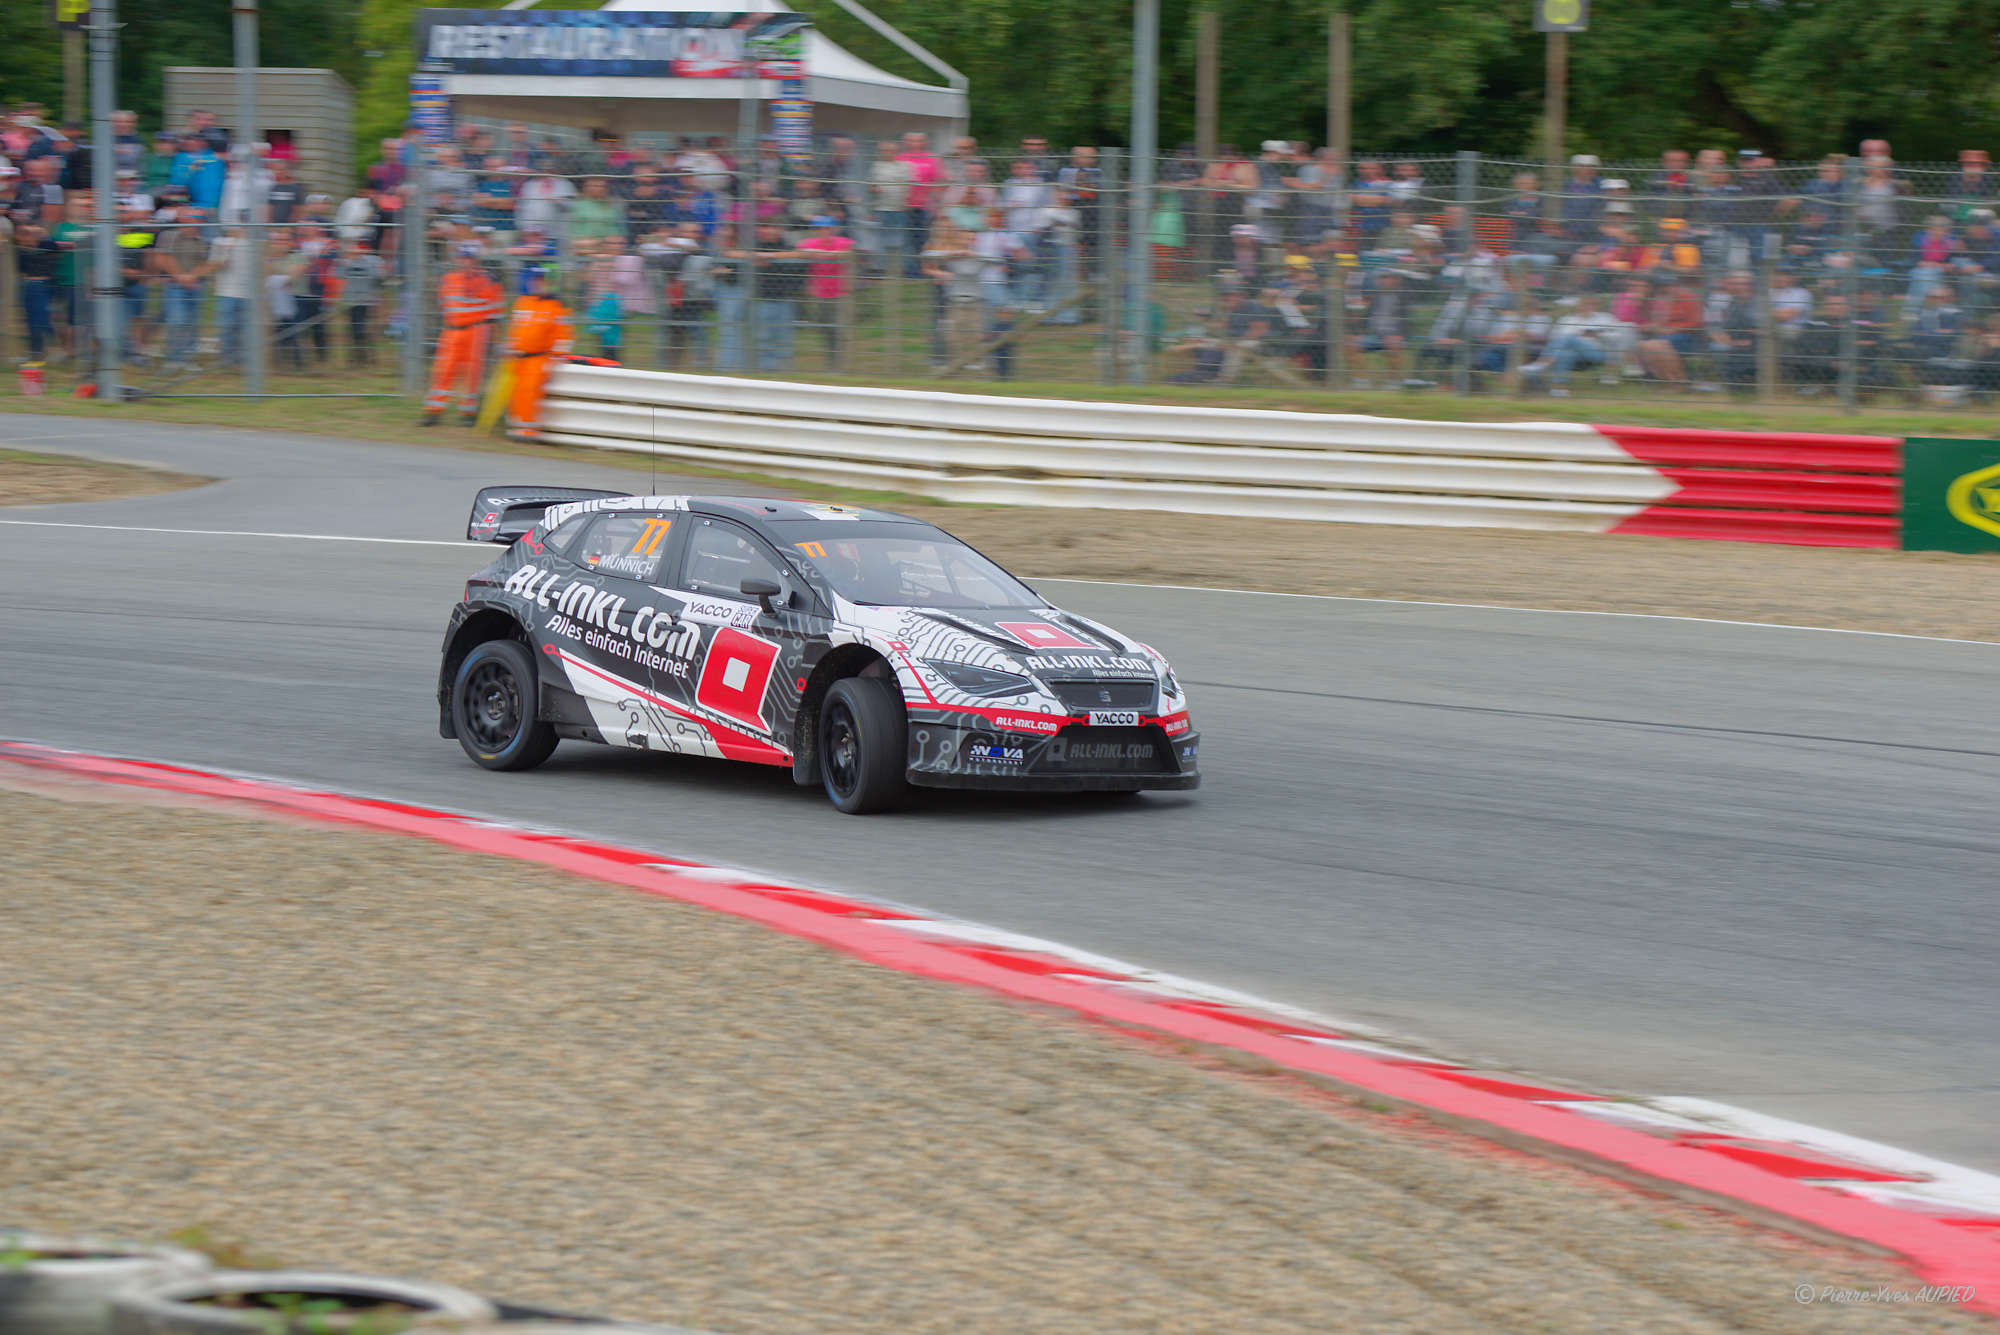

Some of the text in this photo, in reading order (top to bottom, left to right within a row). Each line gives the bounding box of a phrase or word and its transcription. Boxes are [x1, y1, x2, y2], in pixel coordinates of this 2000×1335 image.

[632, 517, 672, 555] 77
[794, 541, 828, 558] 77
[599, 553, 655, 576] MÜNNICH
[689, 601, 732, 618] YACCO
[545, 614, 689, 679] Alles einfach Internet
[1095, 713, 1134, 725] YACCO
